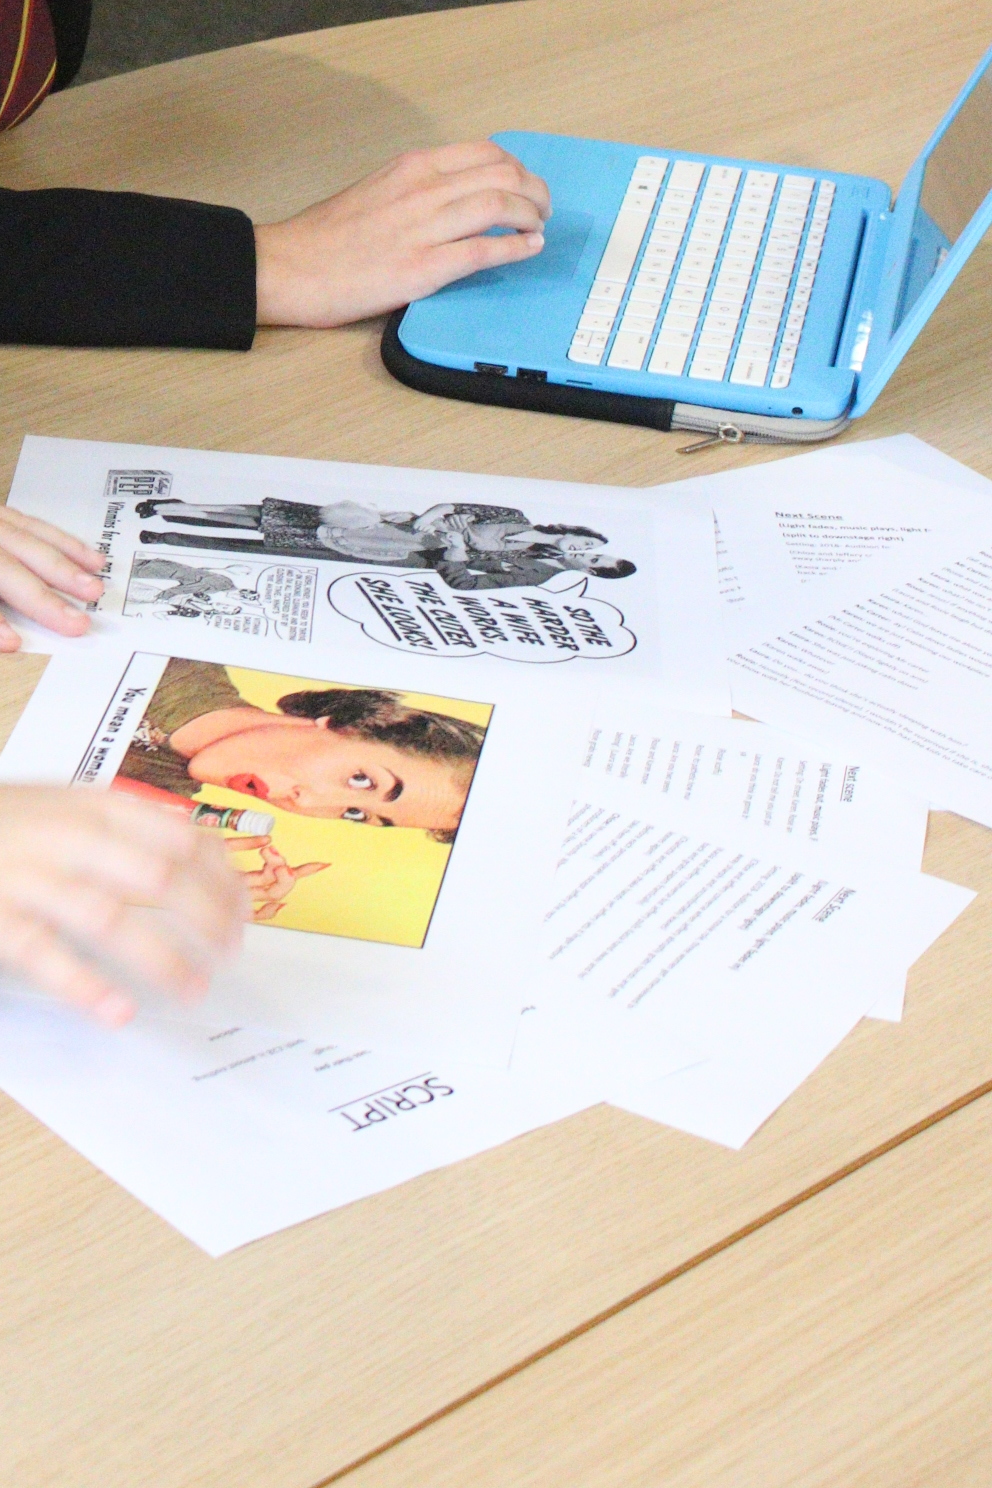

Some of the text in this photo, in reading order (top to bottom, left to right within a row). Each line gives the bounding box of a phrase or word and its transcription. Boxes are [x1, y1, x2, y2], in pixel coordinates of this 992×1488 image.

[116, 475, 156, 495] PEP
[103, 500, 126, 529] Vitamins
[774, 511, 843, 521] Next Scene
[101, 530, 122, 541] for
[360, 577, 438, 651] SHE LOOKS!
[404, 580, 478, 649] THE CUTER
[452, 595, 508, 645] WORKS,
[487, 597, 545, 647] A WIFE
[521, 596, 580, 651] HARDER
[563, 605, 613, 648] SO THE
[865, 620, 878, 628] we
[877, 626, 890, 634] are
[888, 631, 906, 640] just
[121, 687, 148, 704] You
[106, 706, 129, 733] mean
[82, 747, 110, 783] woman
[842, 766, 861, 803] Next scene
[814, 888, 857, 923] Next Scene
[341, 1076, 455, 1132] SCRIPT
